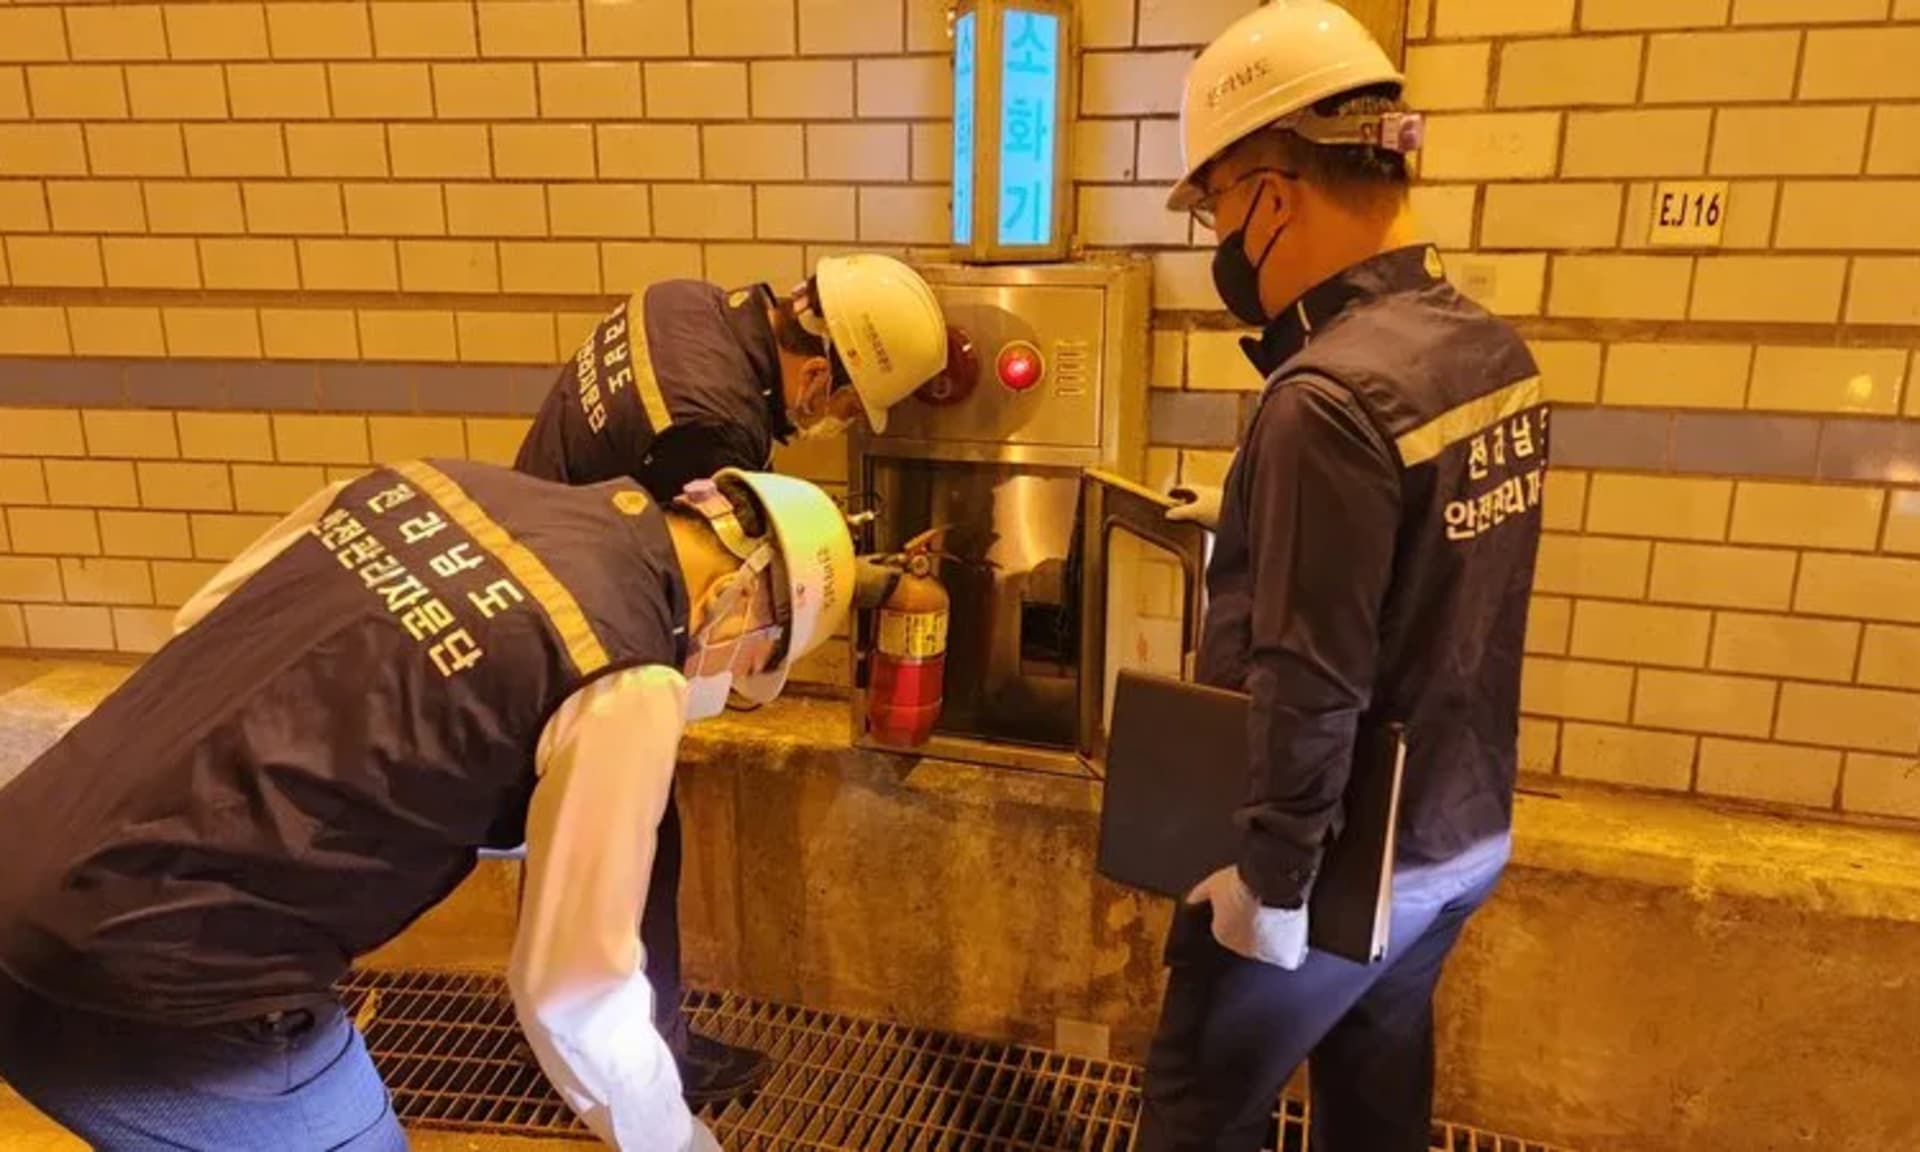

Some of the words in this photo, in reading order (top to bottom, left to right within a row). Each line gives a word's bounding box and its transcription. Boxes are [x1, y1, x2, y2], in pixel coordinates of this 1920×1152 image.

[1004, 13, 1050, 241] 소화기
[1693, 192, 1720, 227] 16
[366, 482, 526, 619] 전라남도
